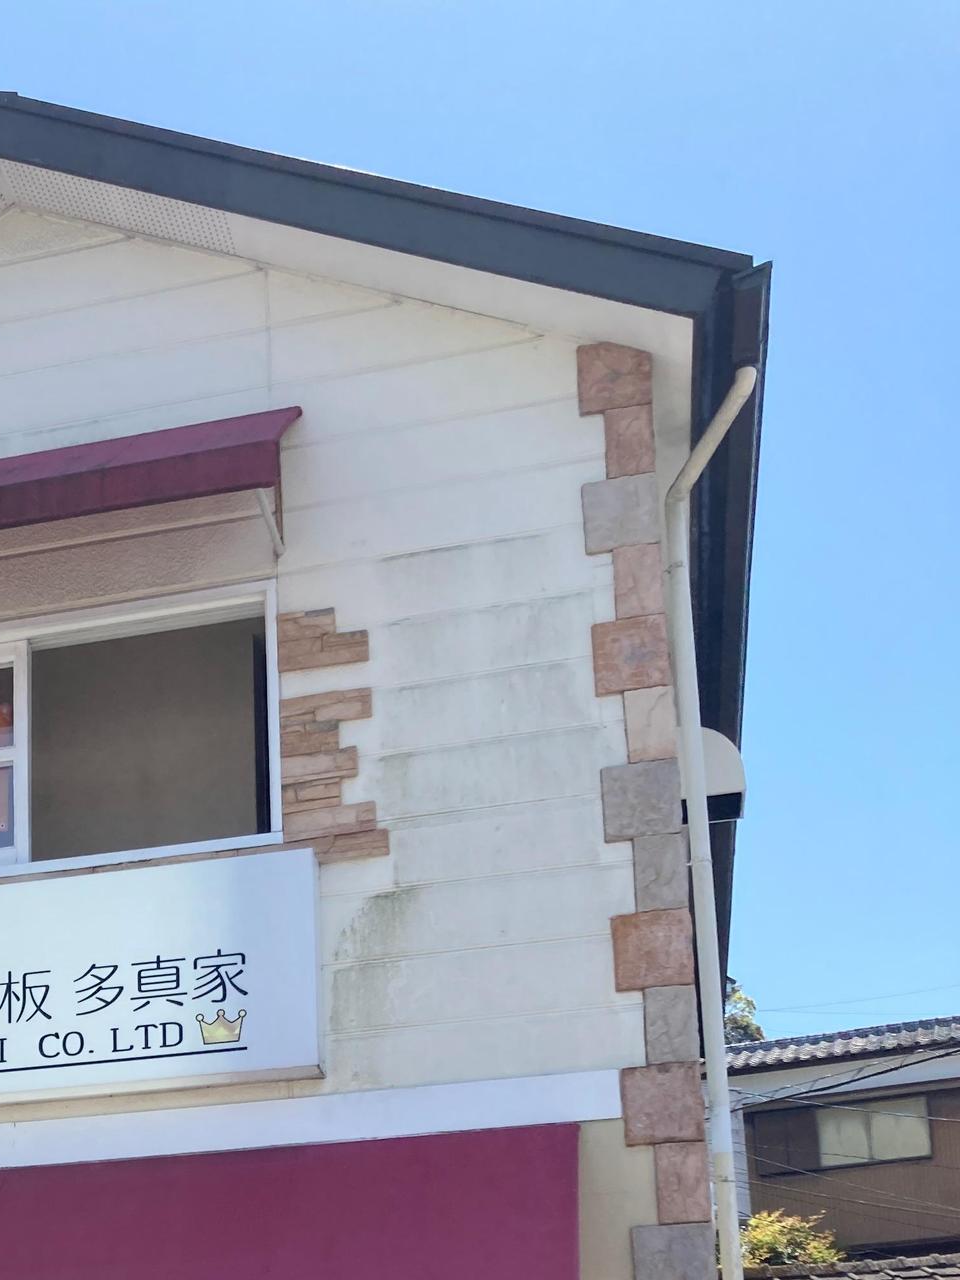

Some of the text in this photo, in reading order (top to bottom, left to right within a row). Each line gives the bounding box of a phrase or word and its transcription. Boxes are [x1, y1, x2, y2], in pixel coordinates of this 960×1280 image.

[73, 949, 248, 1016] 多真家
[38, 1031, 94, 1059] CO.
[110, 1022, 184, 1053] LTD
